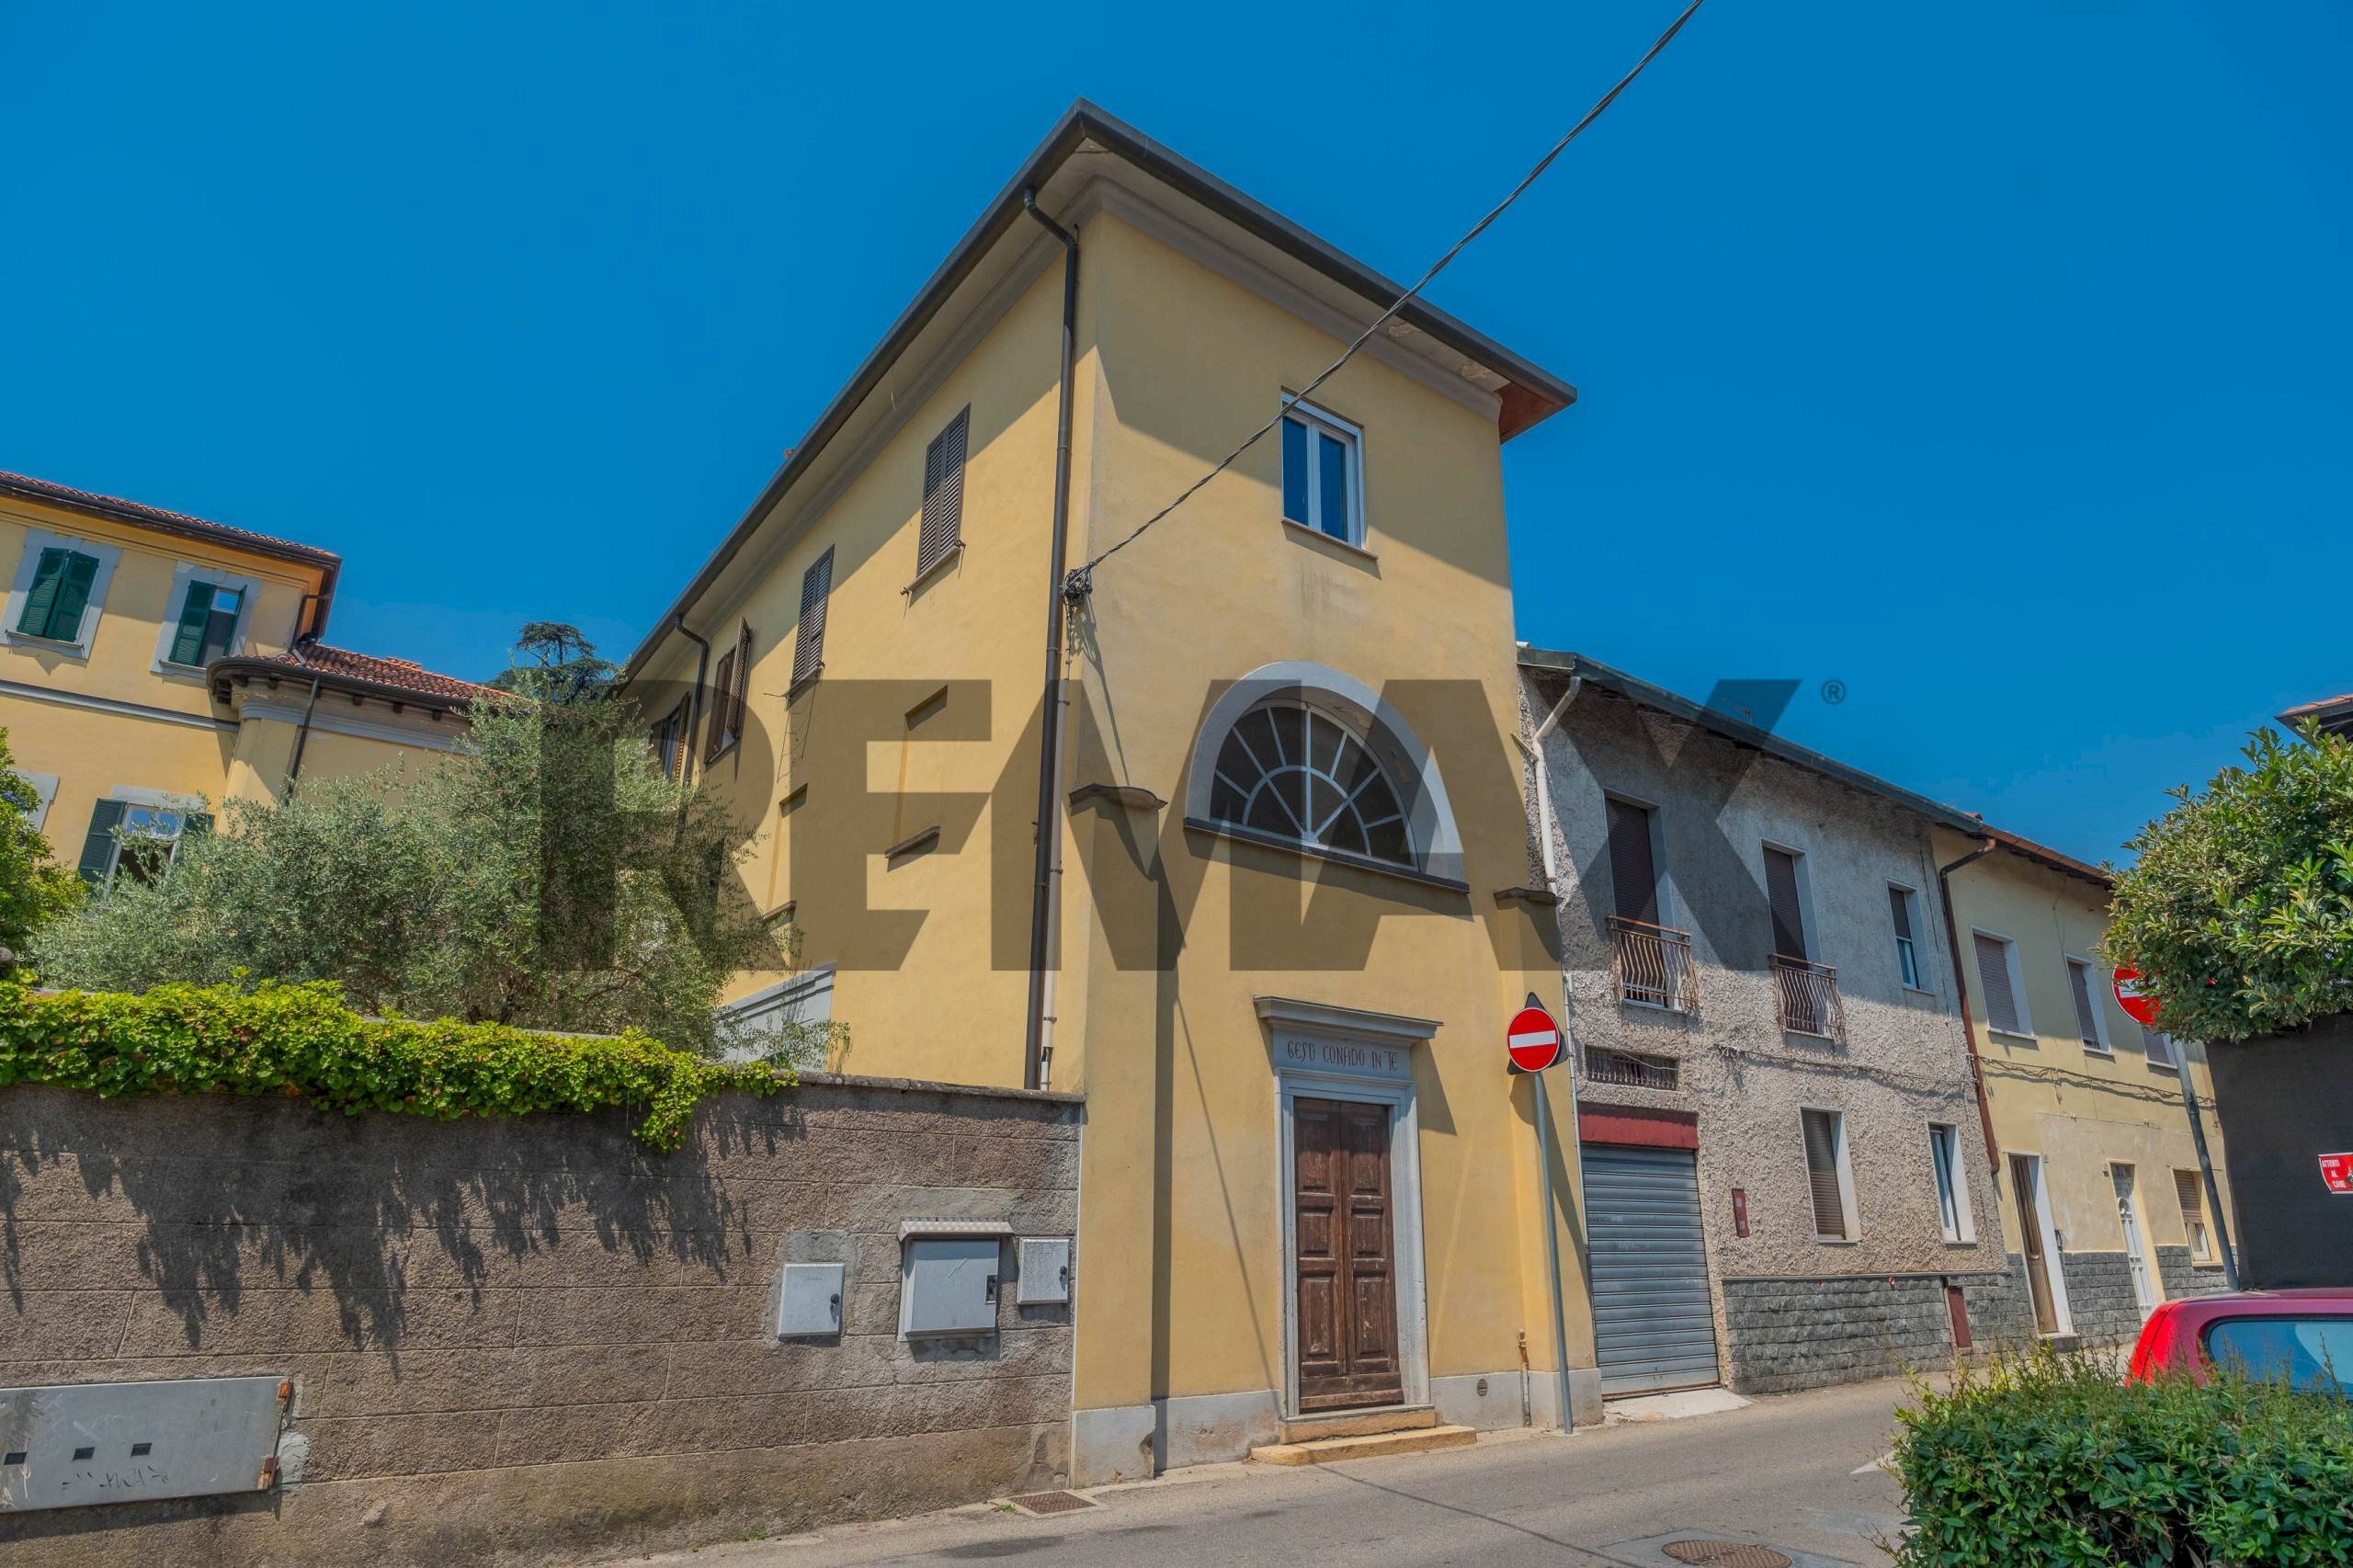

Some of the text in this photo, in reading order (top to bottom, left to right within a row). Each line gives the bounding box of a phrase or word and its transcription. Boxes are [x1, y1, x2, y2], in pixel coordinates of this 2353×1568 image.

[1323, 1044, 1366, 1068] CONFIDO
[1371, 1051, 1382, 1070] IN
[1383, 1051, 1398, 1073] TE
